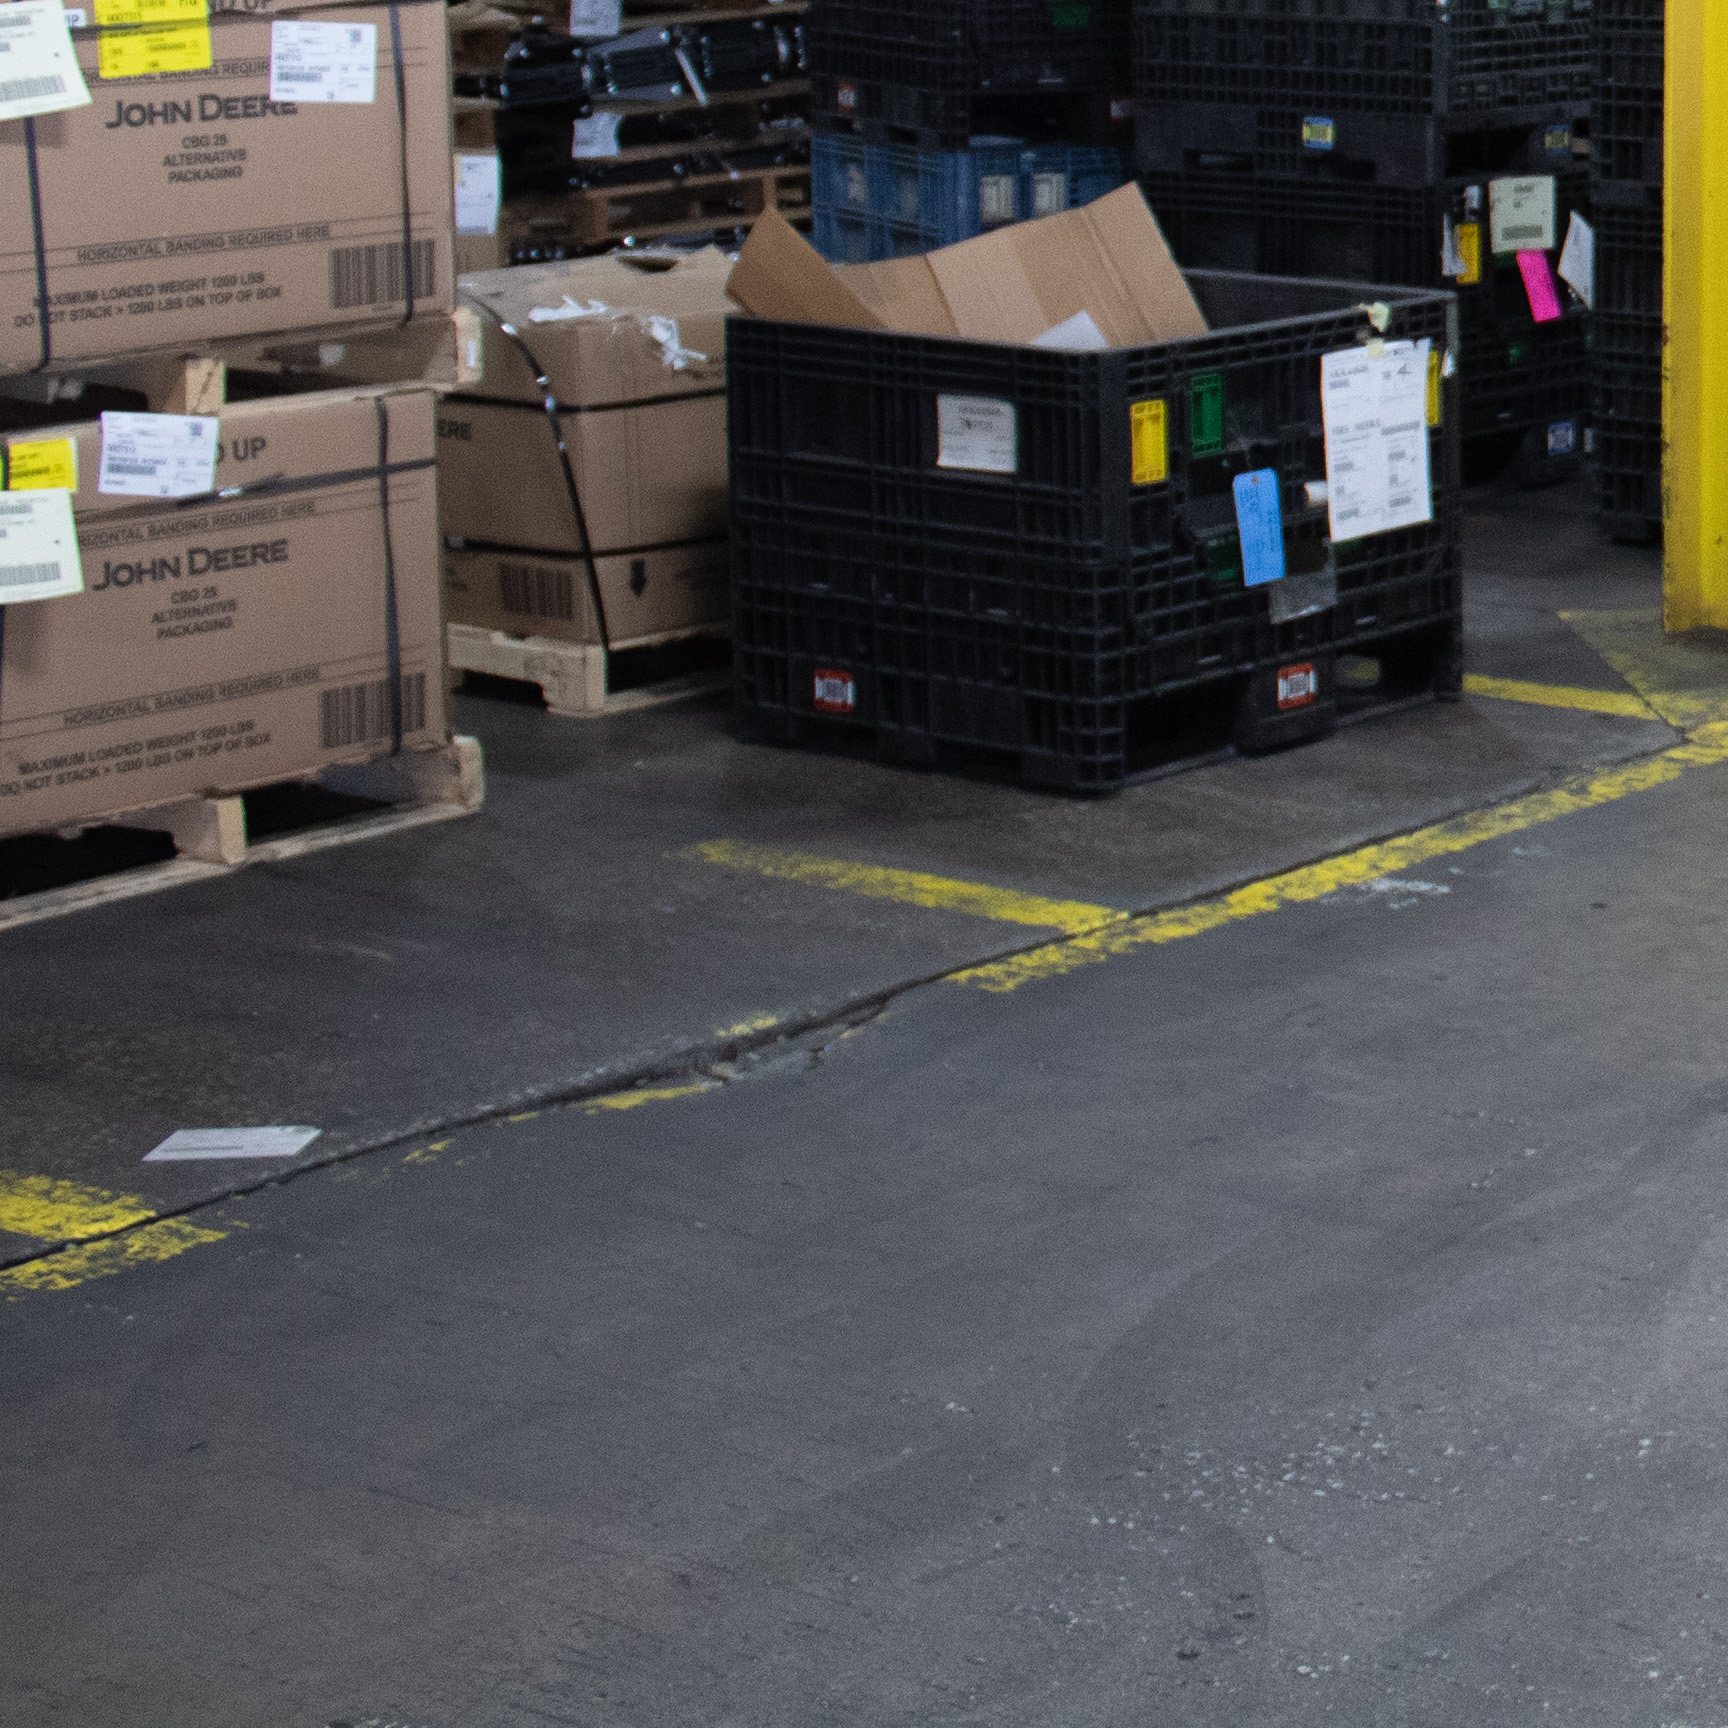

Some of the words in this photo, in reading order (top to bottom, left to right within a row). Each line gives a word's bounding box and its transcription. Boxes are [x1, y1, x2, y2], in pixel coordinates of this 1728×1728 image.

[105, 99, 192, 129] JOHN
[197, 93, 299, 123] DEERE
[182, 135, 210, 149] CBG
[163, 148, 247, 167] ALTERNATIVE
[167, 165, 243, 184] PACKAGING
[77, 242, 162, 263] HORIZONTAL
[165, 236, 226, 255] BANDING
[228, 229, 294, 247] REQUIRED
[296, 225, 331, 241] HERE
[102, 284, 155, 301] LOADED
[157, 277, 208, 295] WEIGHT
[240, 272, 265, 285] LBS
[69, 304, 112, 322] STACK
[158, 297, 183, 312] LBS
[186, 294, 206, 309] ON
[209, 290, 233, 306] TOP
[235, 288, 252, 302] OF
[255, 285, 283, 300] BOX
[232, 436, 267, 463] UP
[92, 556, 181, 591] JOHN
[186, 538, 289, 576] DEERE
[151, 599, 237, 624] ALTERNATIVE
[156, 615, 233, 640] PACKAGING
[64, 702, 151, 727] HORIZONTAL
